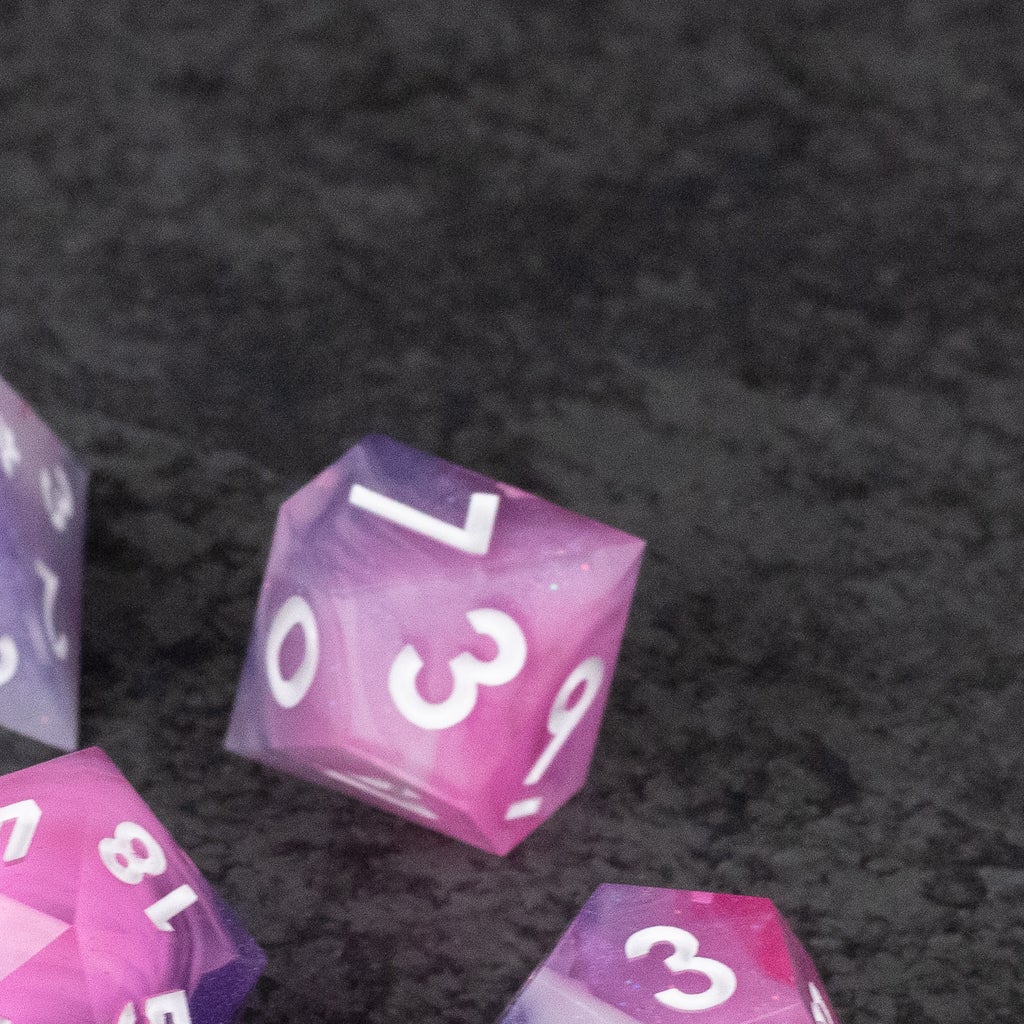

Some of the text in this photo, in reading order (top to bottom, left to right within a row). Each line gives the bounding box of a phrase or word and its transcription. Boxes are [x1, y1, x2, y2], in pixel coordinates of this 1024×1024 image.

[348, 483, 500, 556] 7
[266, 596, 319, 709] 0
[388, 608, 528, 730] 3
[624, 925, 737, 1011] 3
